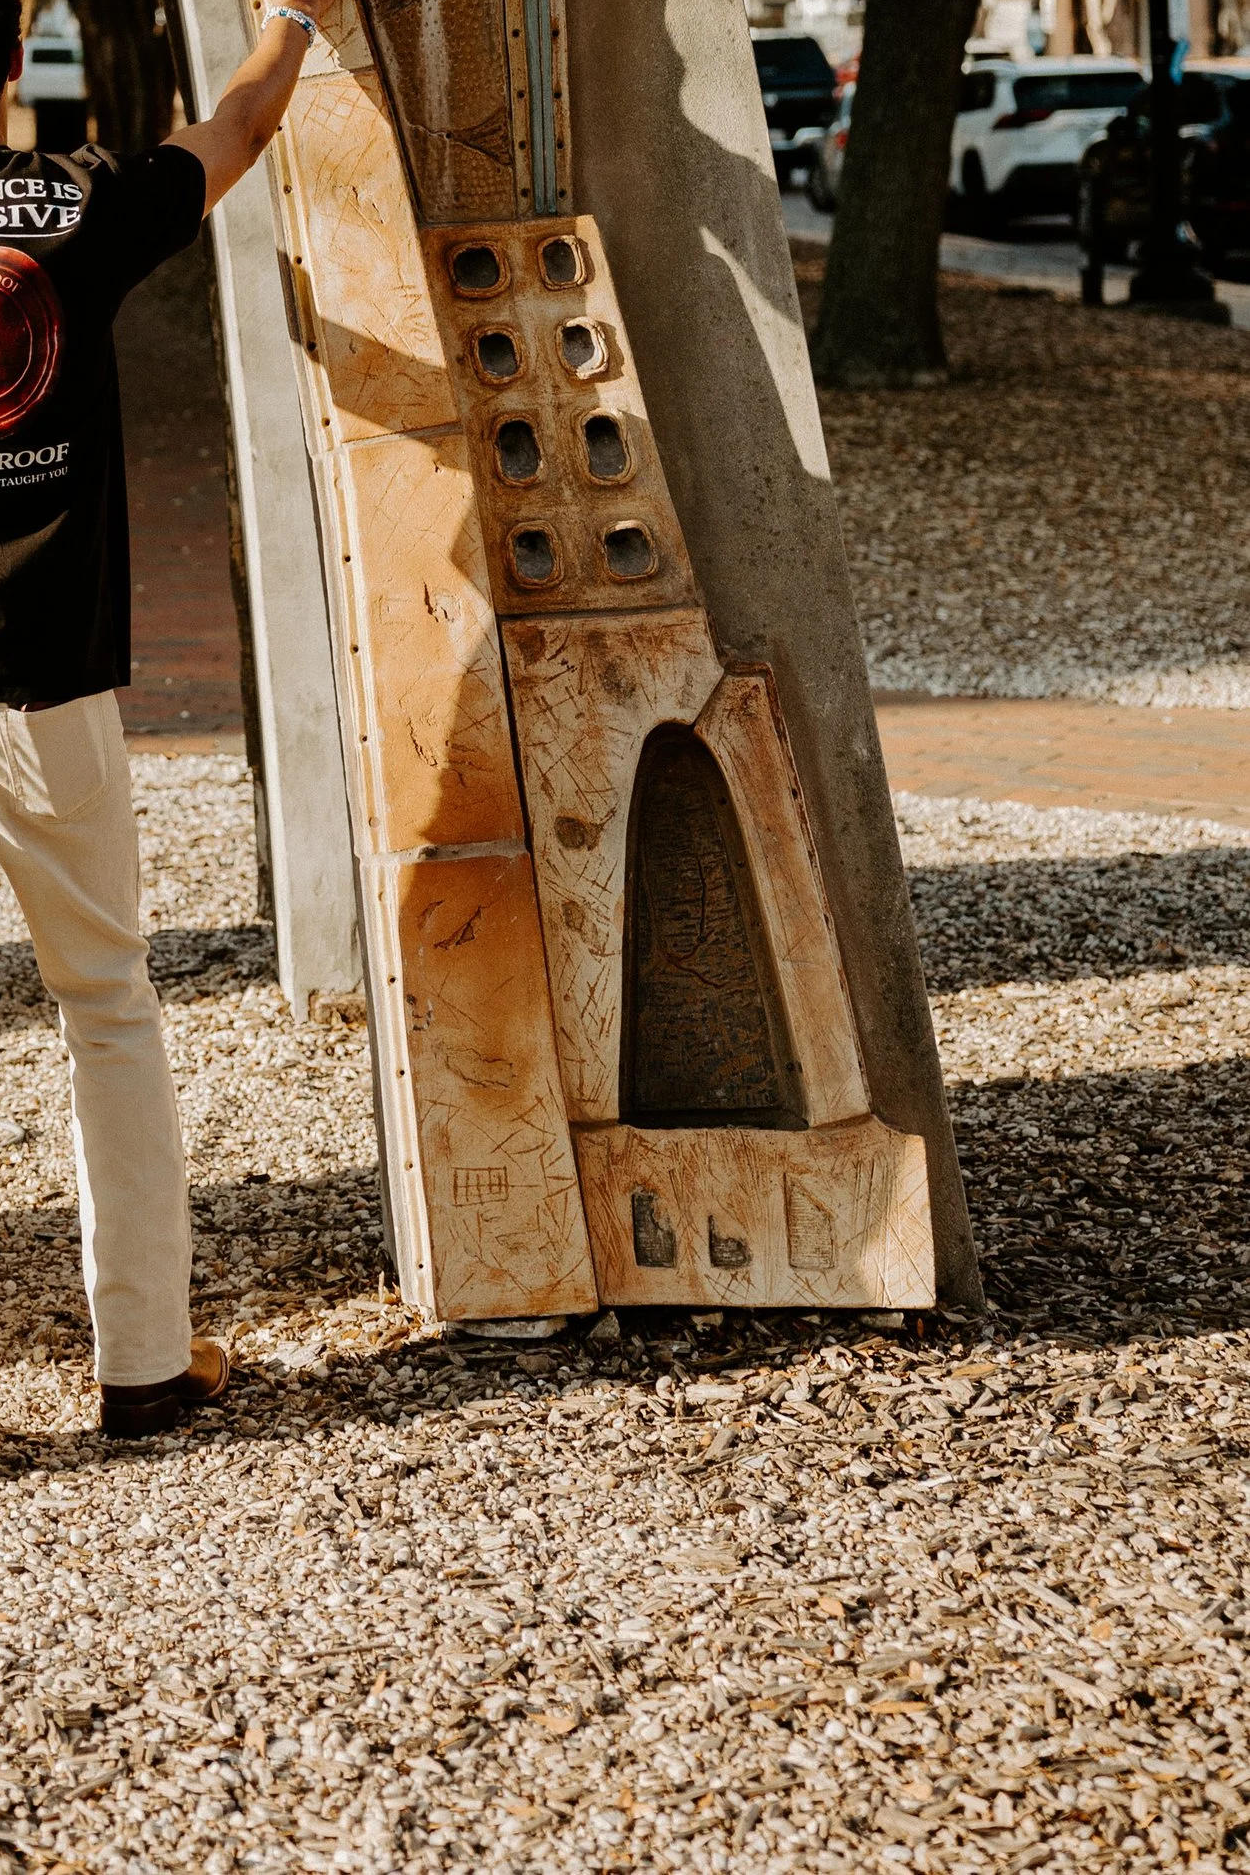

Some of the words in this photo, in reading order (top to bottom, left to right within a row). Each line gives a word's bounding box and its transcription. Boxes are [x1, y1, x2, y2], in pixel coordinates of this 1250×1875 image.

[51, 181, 83, 201] IS
[0, 473, 47, 488] TAUGHT
[48, 466, 69, 479] YOU
